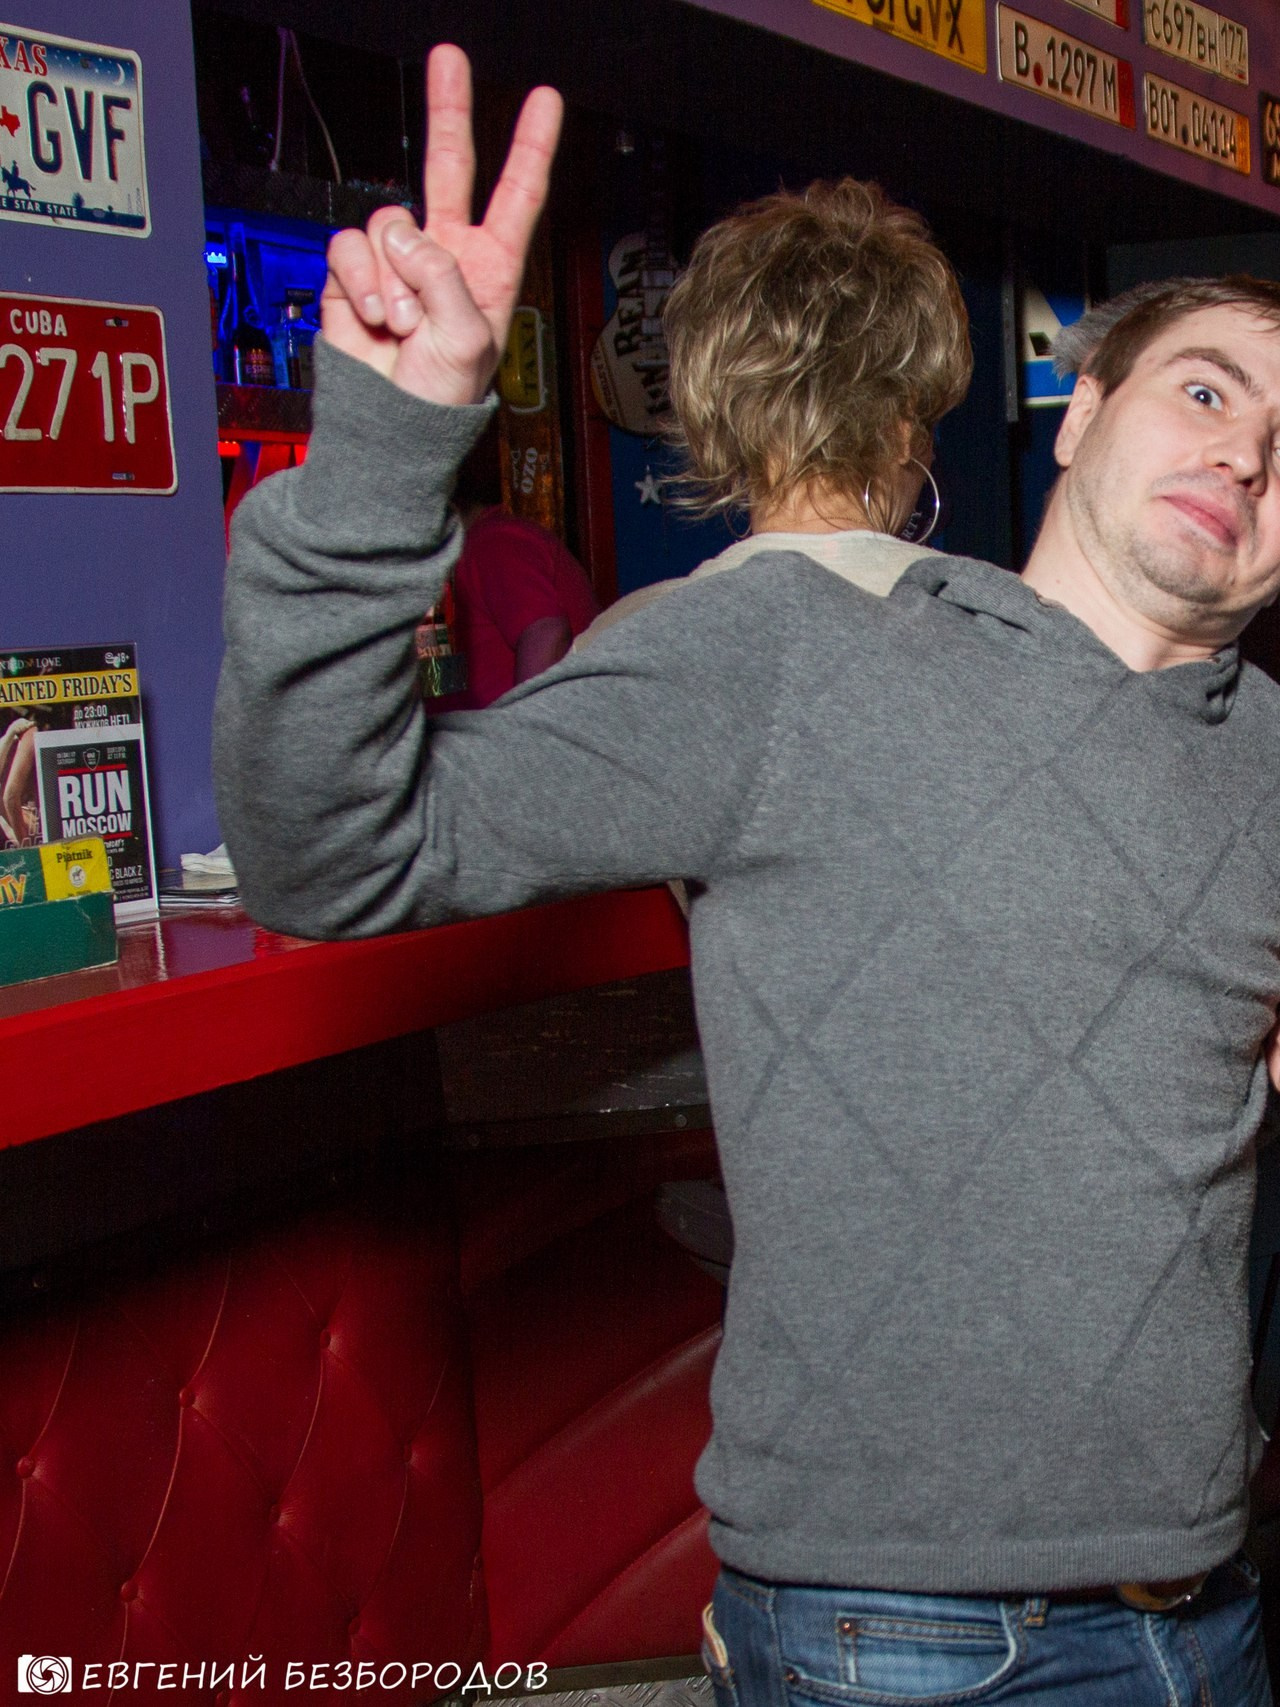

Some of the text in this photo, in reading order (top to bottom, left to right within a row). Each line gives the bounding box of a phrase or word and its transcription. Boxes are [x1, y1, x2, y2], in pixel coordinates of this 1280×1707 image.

[27, 81, 132, 182] GVF
[14, 200, 41, 212] STAR
[47, 205, 78, 217] STATE
[10, 309, 68, 336] CUBA
[0, 344, 160, 444] 271P
[36, 657, 62, 669] LOVE
[62, 673, 132, 697] FRIDAY'S
[84, 705, 108, 718] 23:00
[58, 770, 132, 818] RUN
[62, 812, 132, 839] MOSCOW
[56, 849, 93, 863] Piatnik
[115, 866, 137, 879] BLACK
